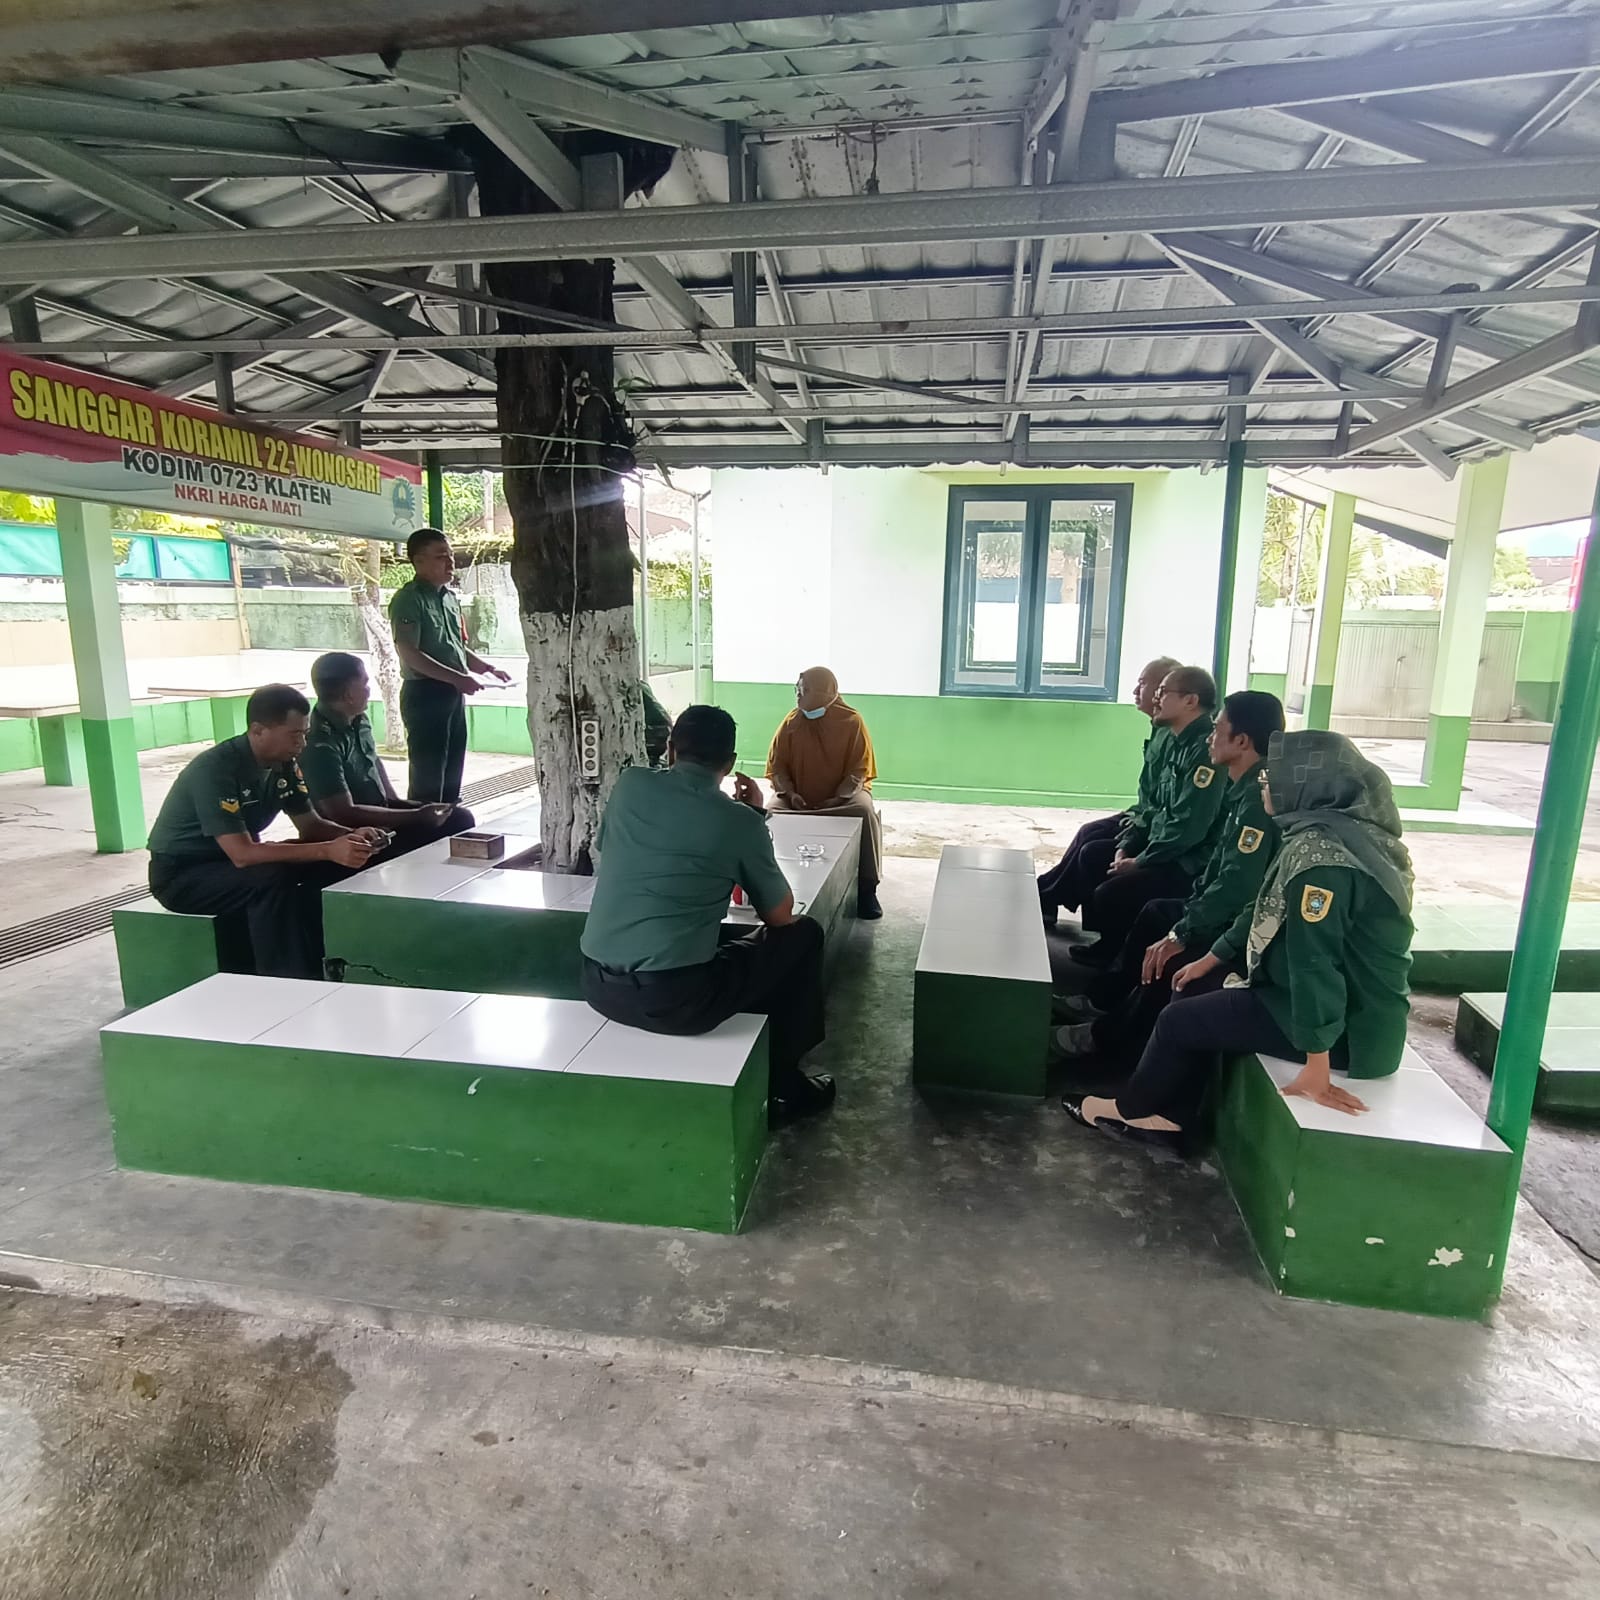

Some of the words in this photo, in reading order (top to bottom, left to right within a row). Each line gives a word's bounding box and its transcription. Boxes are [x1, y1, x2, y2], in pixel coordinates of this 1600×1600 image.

[9, 369, 155, 447] SANGGAR
[160, 412, 263, 468] KORAMIL
[263, 436, 382, 495] 22-WONOSARI
[122, 447, 205, 483] KODIM
[210, 463, 258, 492] 0723
[264, 476, 332, 505] KLATEN
[174, 484, 214, 504] NKRI
[219, 491, 268, 512] HARGA
[271, 499, 302, 517] MATI
